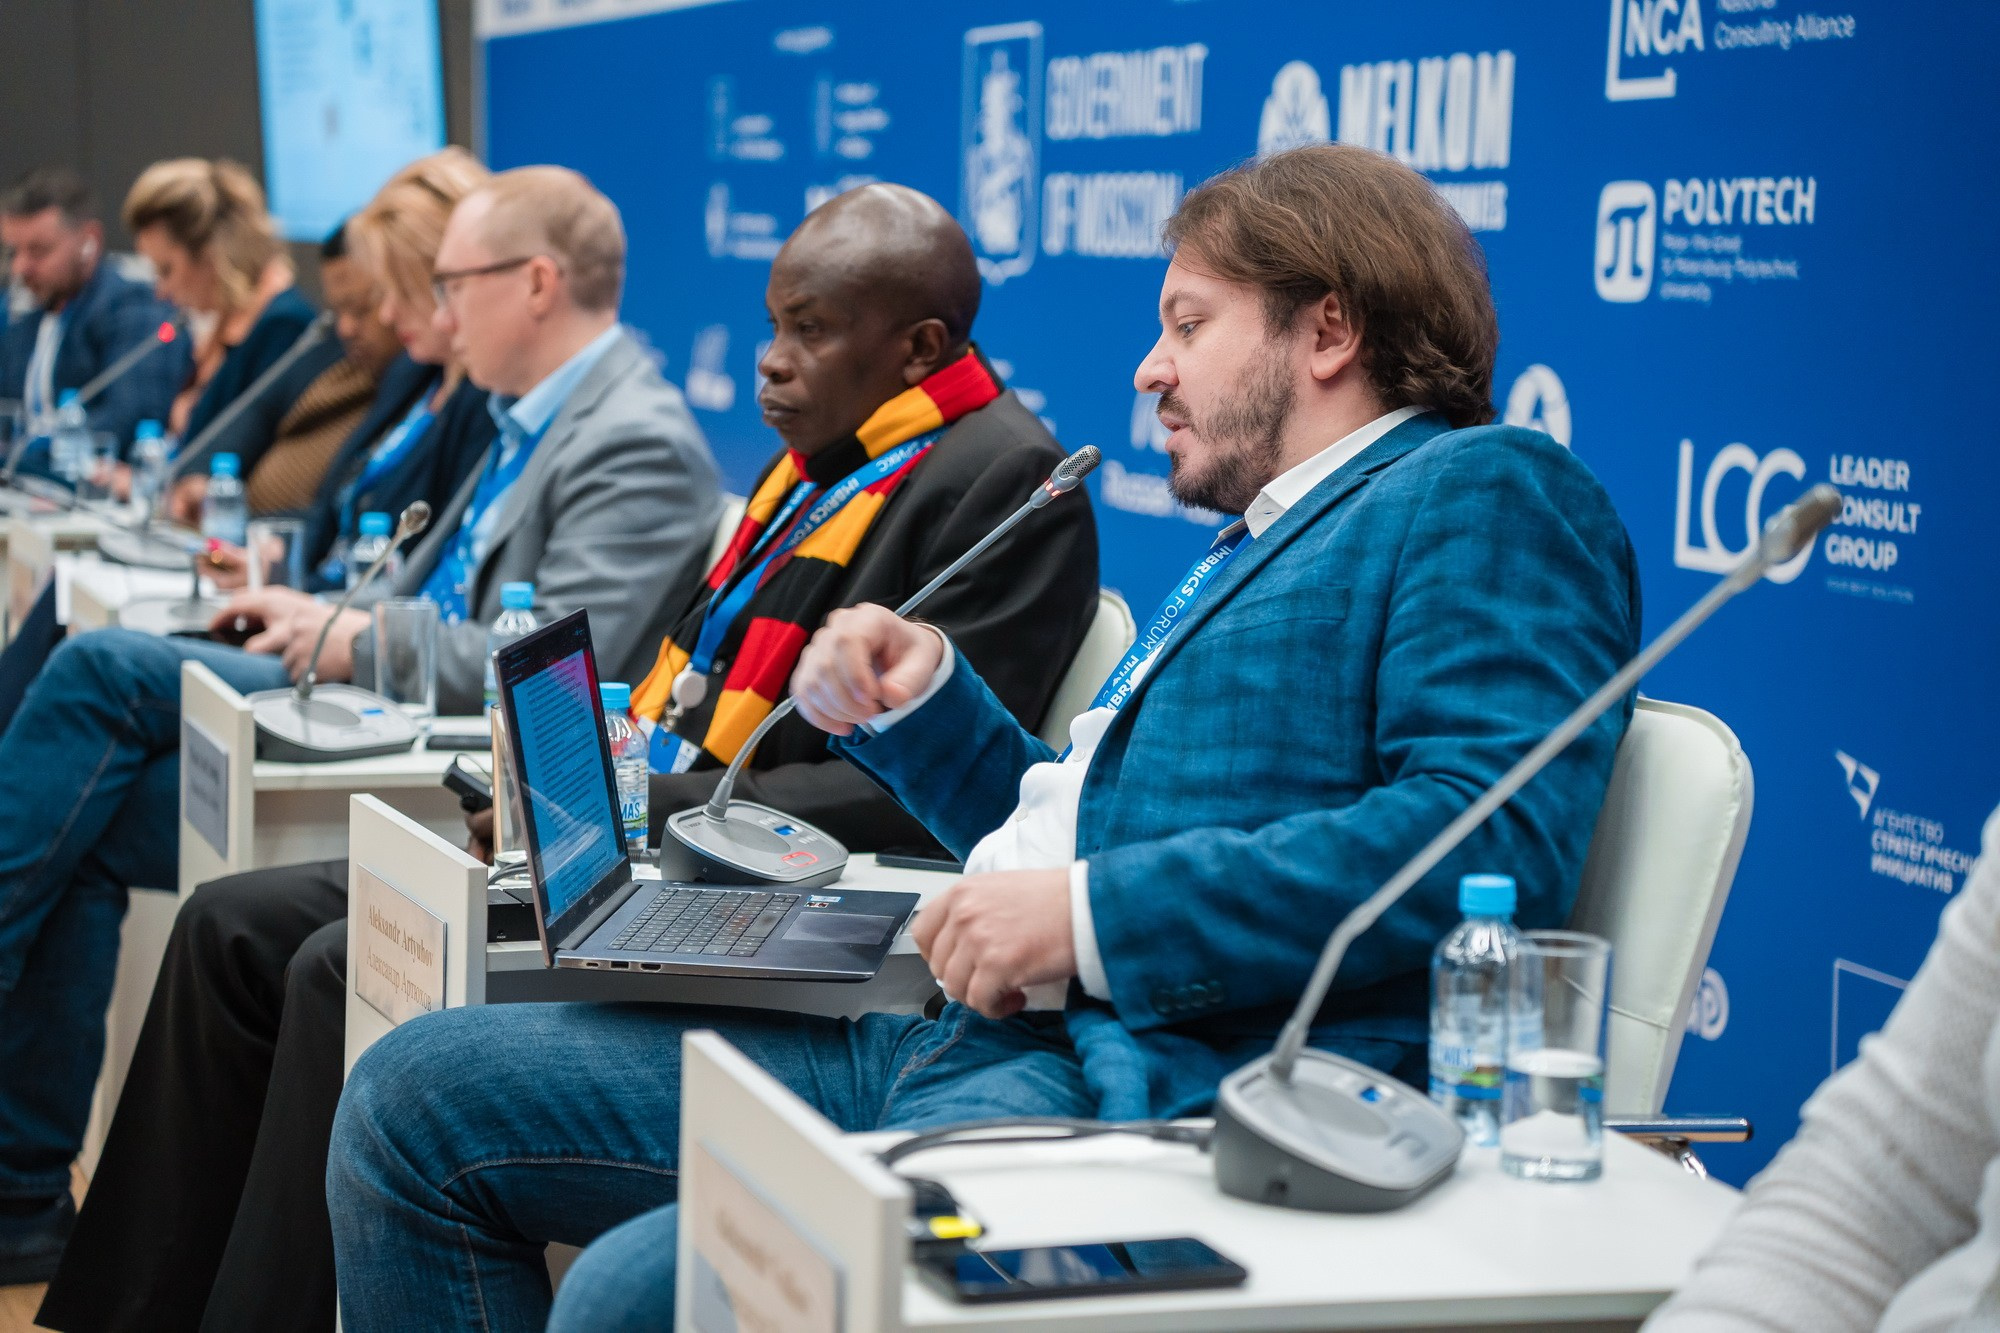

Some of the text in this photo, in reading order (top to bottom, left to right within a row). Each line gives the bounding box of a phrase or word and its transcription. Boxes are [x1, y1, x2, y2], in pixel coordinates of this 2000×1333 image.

[1624, 0, 1704, 57] NCA
[1662, 176, 1816, 225] POLYTECH
[1829, 453, 1910, 492] LEADER
[1825, 533, 1898, 572] GROUP
[1141, 545, 1233, 650] IMBRICS FORUM
[368, 904, 400, 945] Aleksandr
[366, 945, 400, 994] Александр
